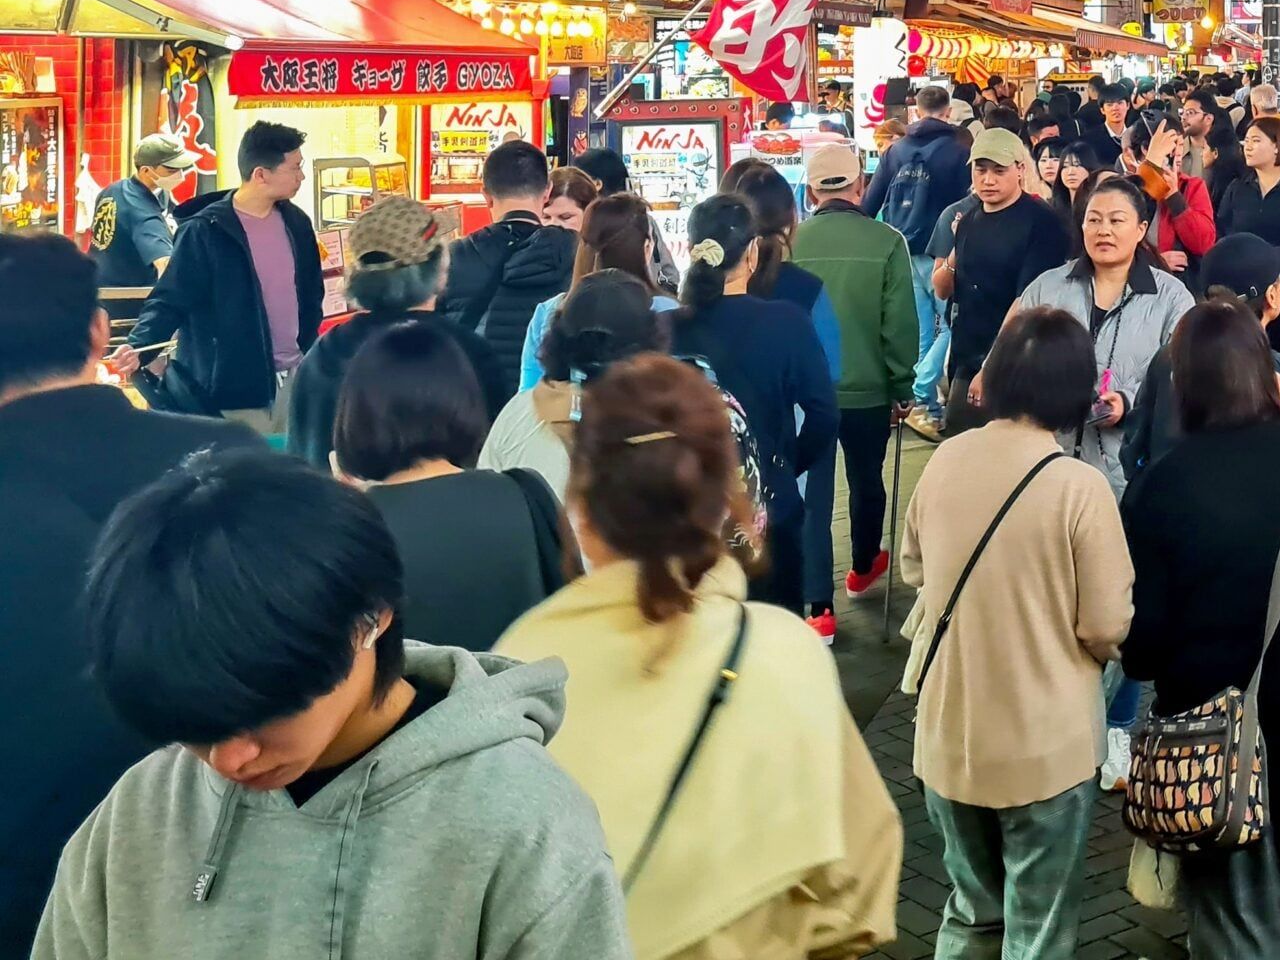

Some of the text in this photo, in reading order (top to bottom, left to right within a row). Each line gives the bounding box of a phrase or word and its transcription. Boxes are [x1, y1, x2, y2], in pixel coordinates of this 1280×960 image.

[261, 56, 339, 92] 大阪王将
[351, 59, 407, 91] ギョーザ
[455, 62, 514, 91] GYOZA
